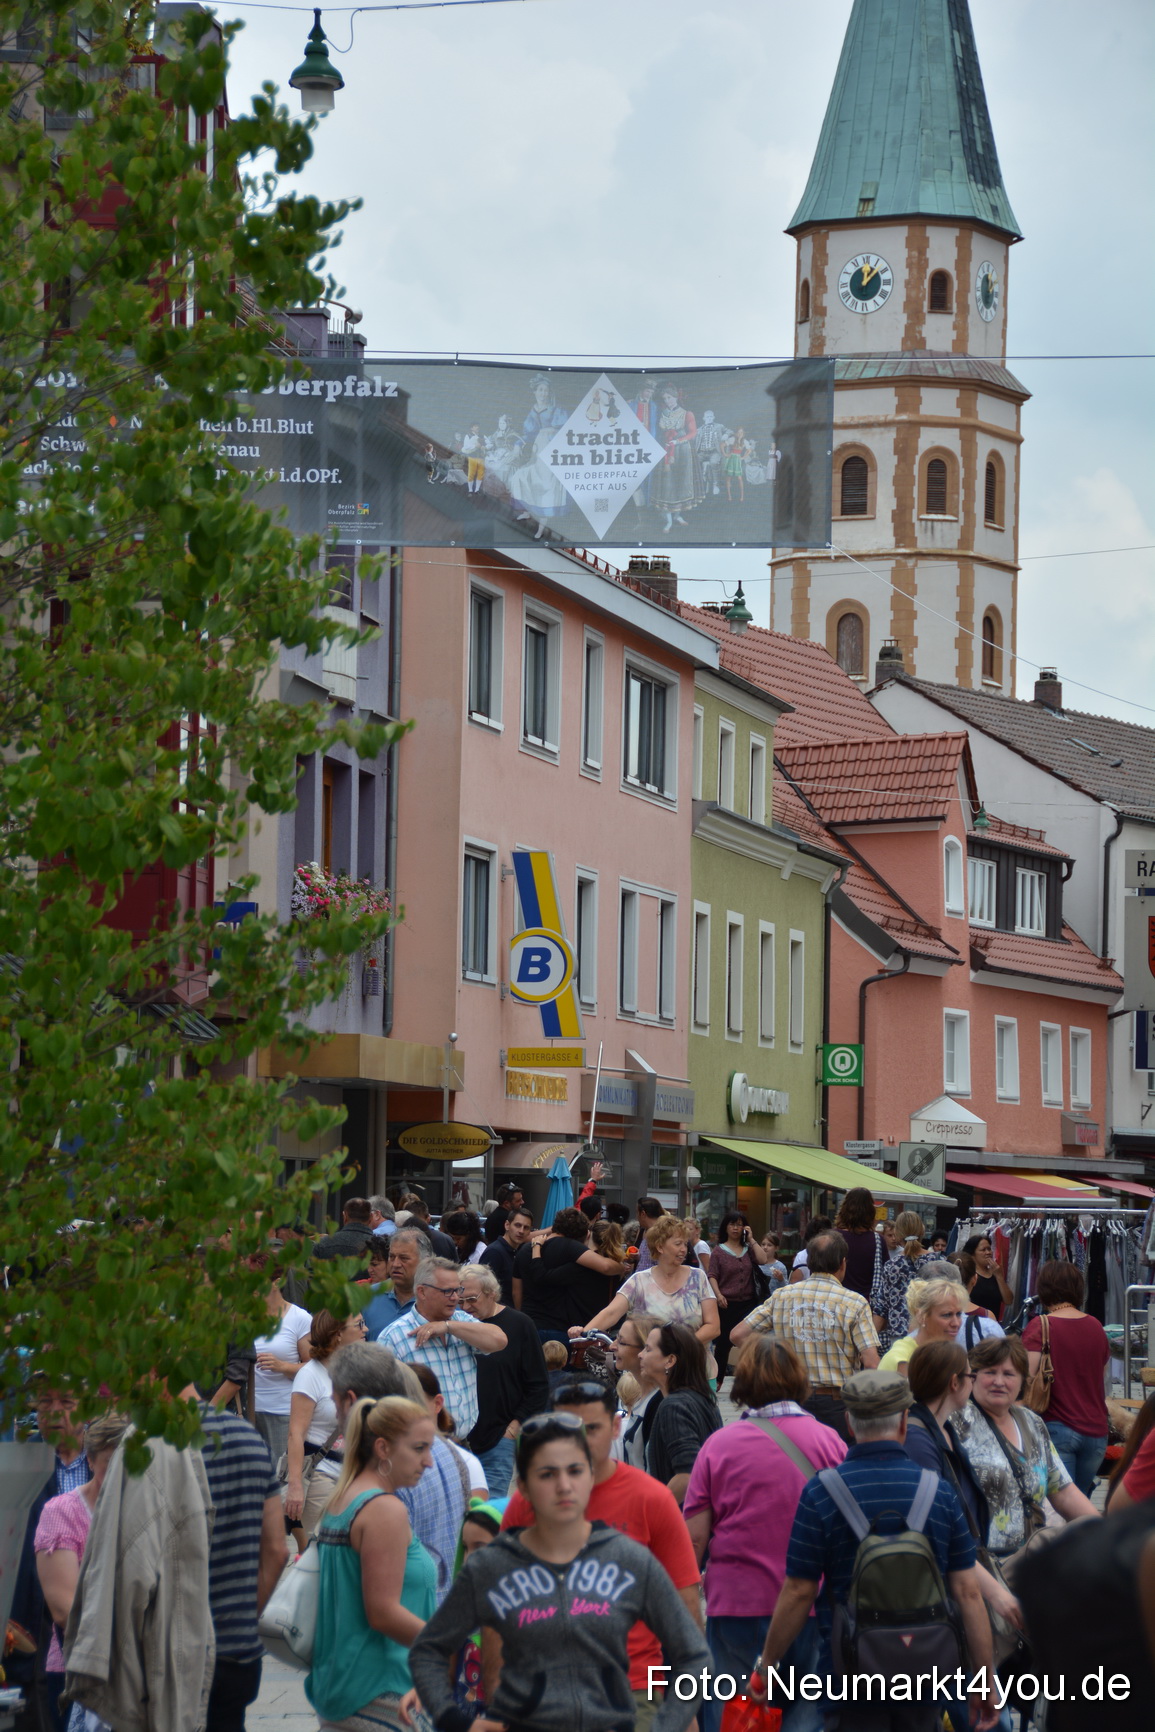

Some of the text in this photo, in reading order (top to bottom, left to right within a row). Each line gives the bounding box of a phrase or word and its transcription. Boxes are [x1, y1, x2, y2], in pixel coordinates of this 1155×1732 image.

[566, 428, 640, 446] tracht
[550, 448, 652, 466] im blick
[280, 467, 342, 484] i.d.OPf.
[564, 470, 638, 480] DIE OBERPFALZ
[574, 483, 627, 491] PACKT AUS
[516, 947, 552, 983] B
[511, 1053, 579, 1062] KLOSTERGASSE 4
[925, 1121, 973, 1139] Creppresso
[403, 1137, 489, 1146] DIE GOLDSCHMIEDE
[846, 1142, 876, 1150] Klostergasse
[914, 1179, 932, 1187] ONE
[488, 1558, 636, 1620] AERO 1987
